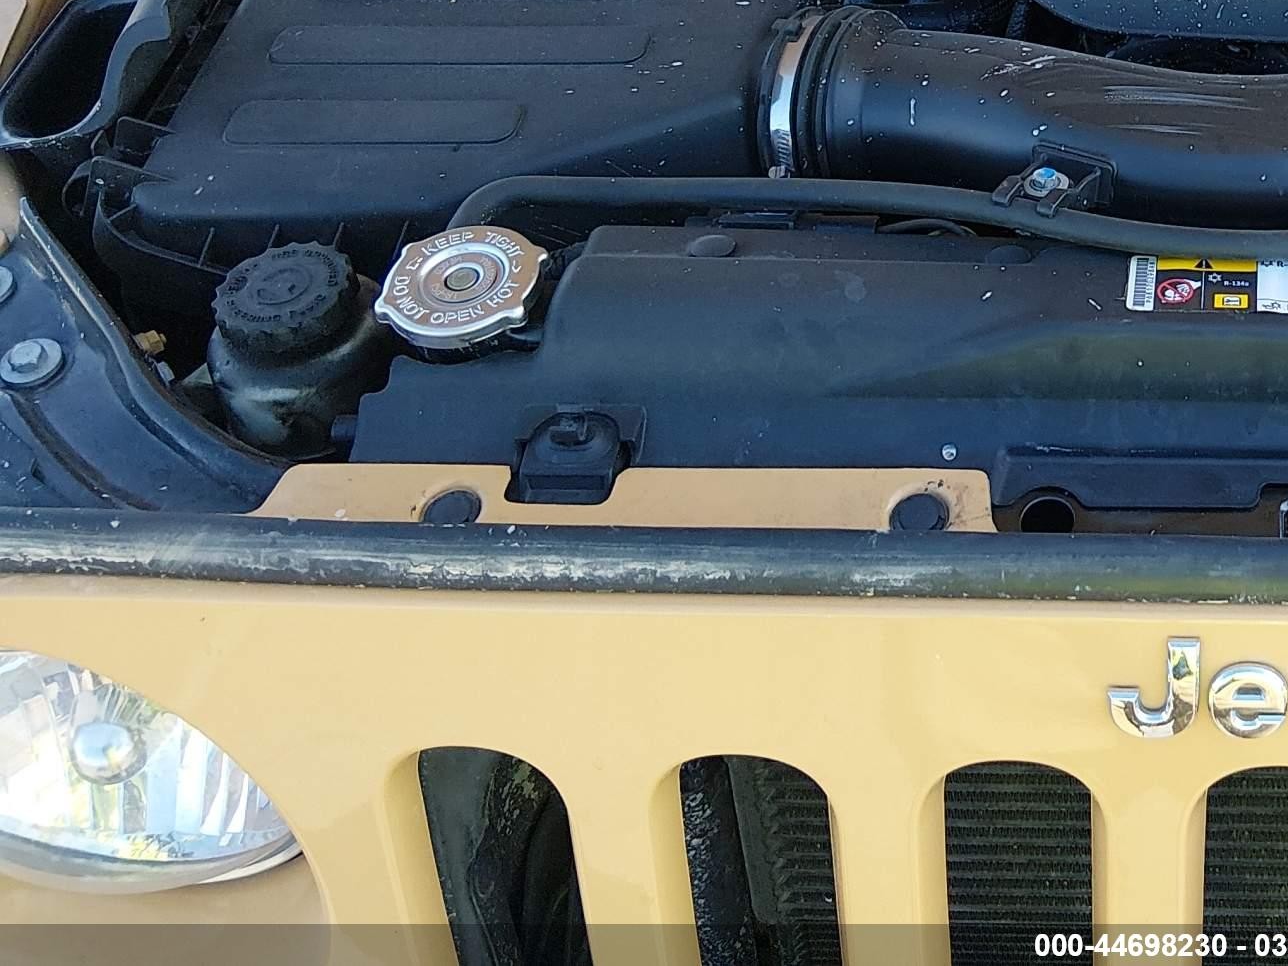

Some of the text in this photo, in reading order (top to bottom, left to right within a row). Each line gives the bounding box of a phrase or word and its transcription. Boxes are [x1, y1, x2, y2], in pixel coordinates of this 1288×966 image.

[421, 231, 525, 257] KEEP TIGHT
[393, 276, 520, 324] DO NOT OPEN HOT
